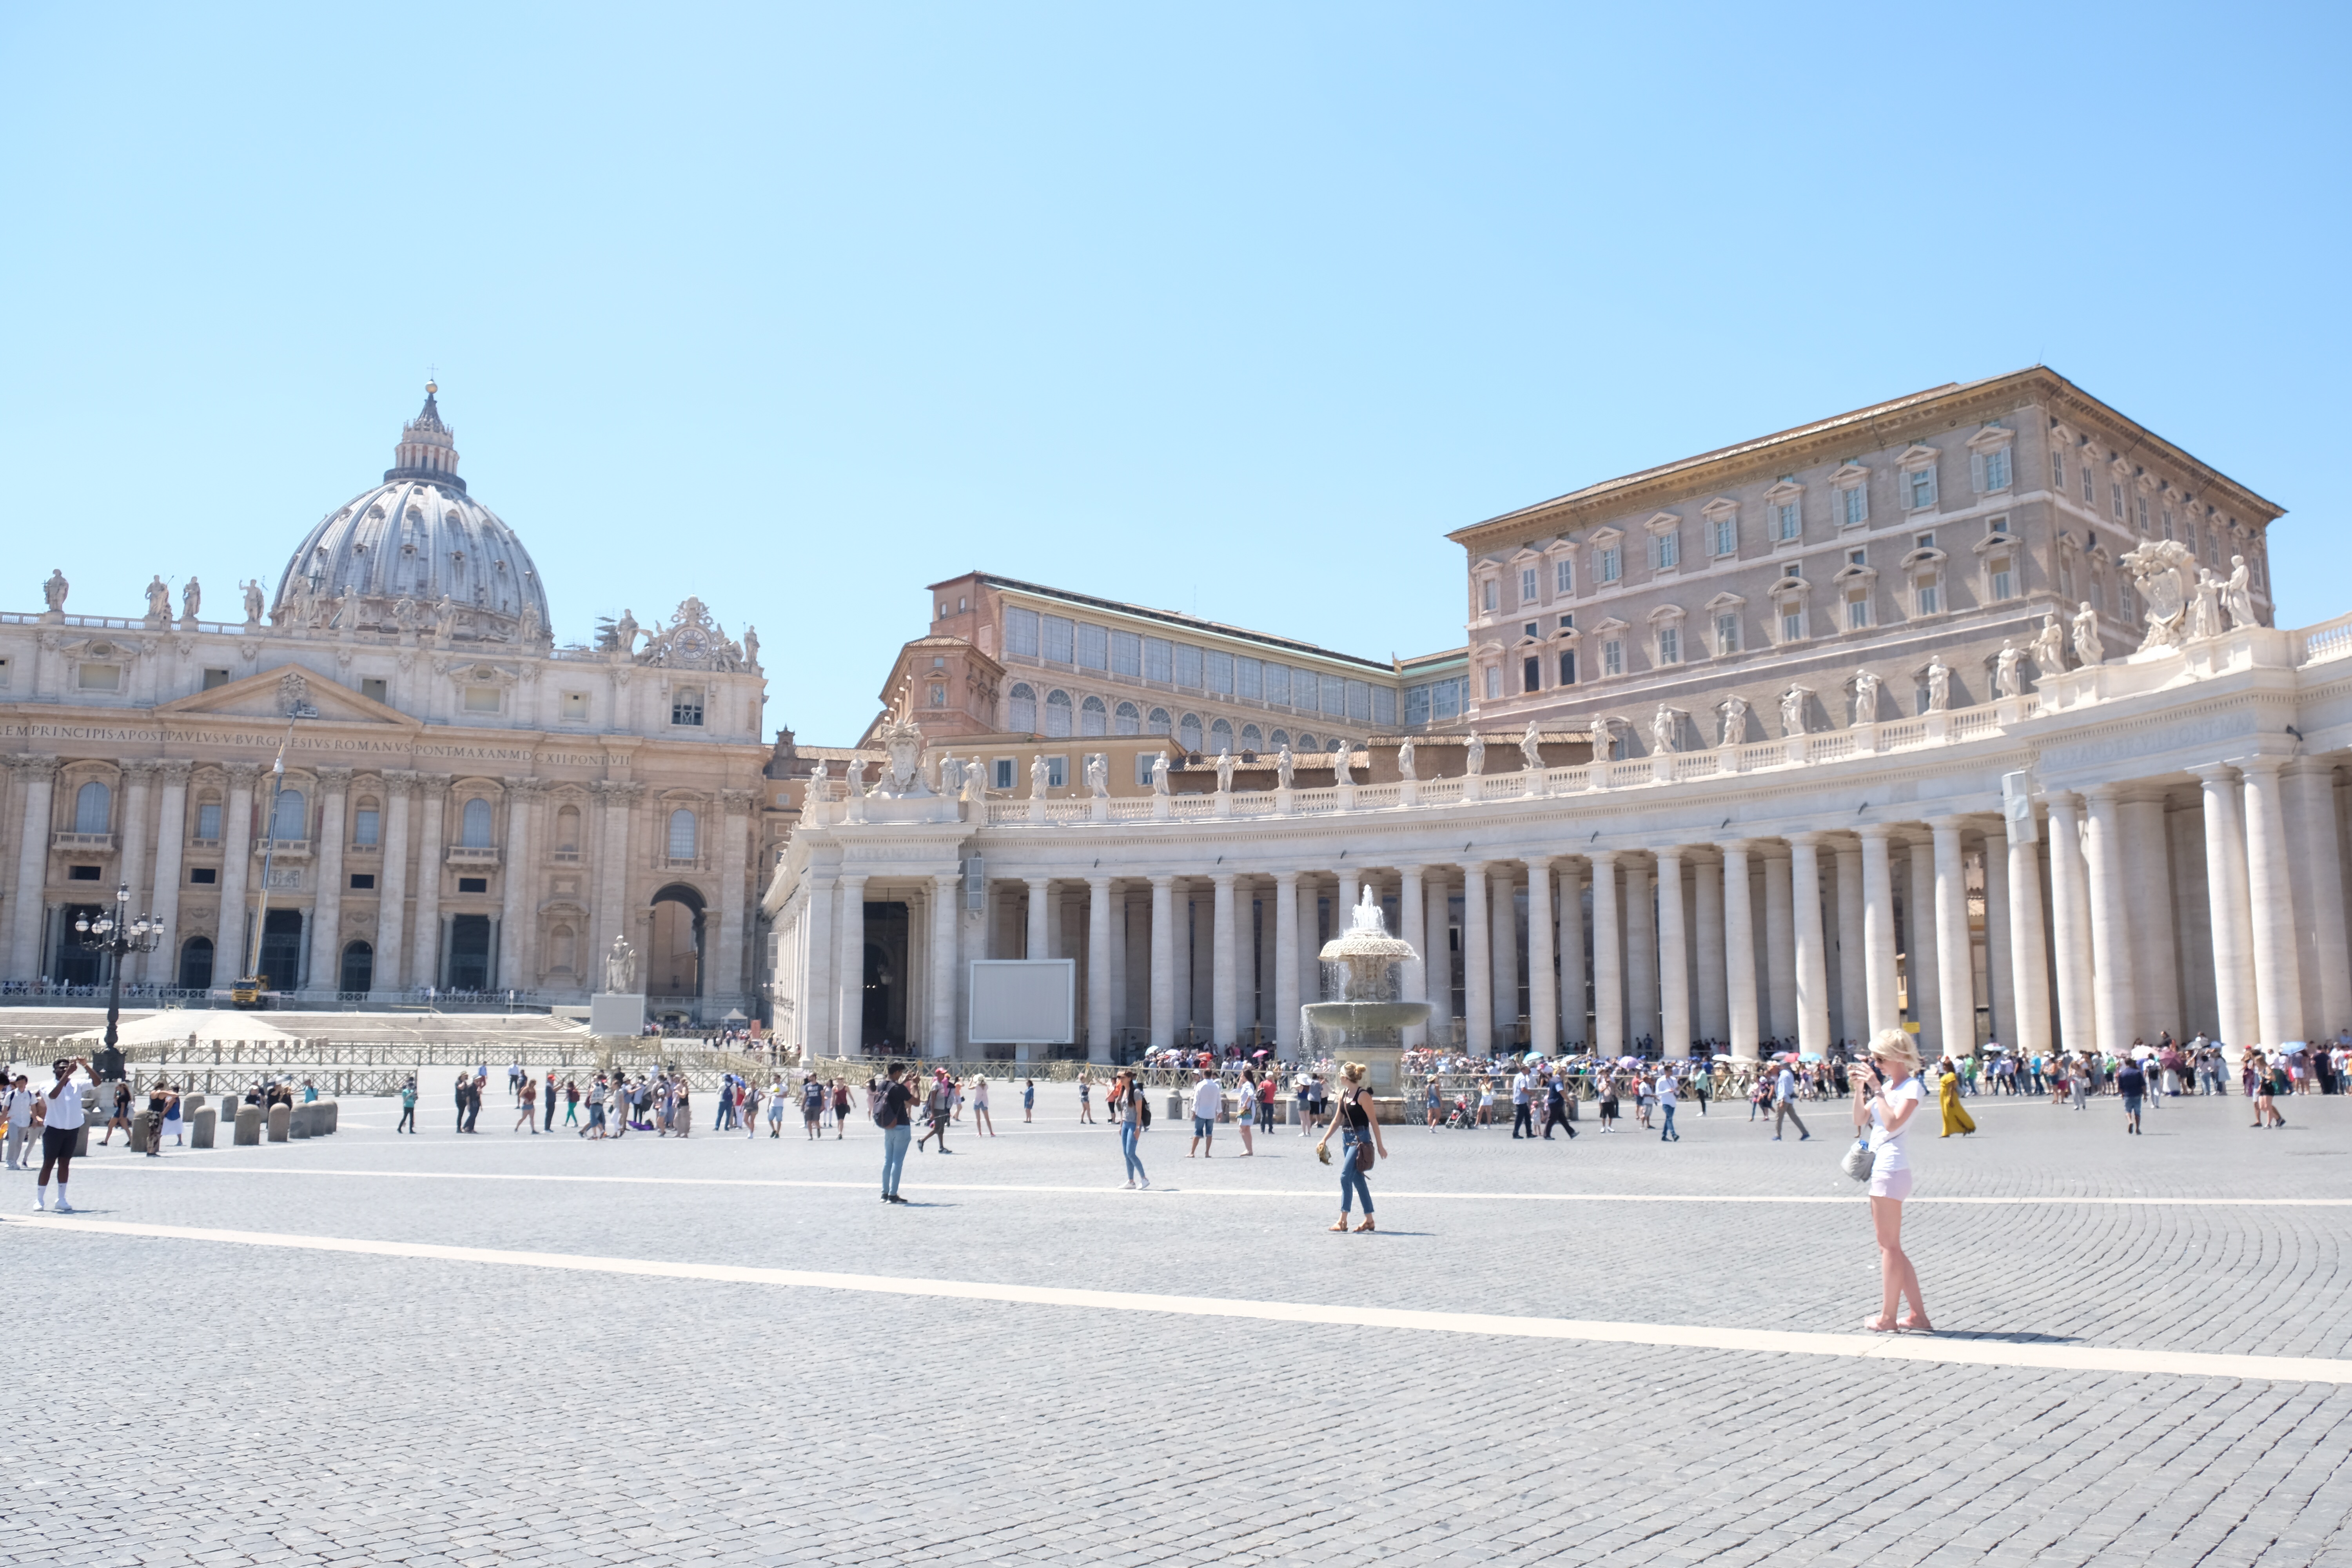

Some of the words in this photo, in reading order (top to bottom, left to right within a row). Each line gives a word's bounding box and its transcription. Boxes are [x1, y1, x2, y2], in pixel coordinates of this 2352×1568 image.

[0, 726, 28, 736] EM
[31, 726, 113, 740] PRINCIPIS
[335, 740, 410, 753] ROMANVS
[611, 755, 630, 765] VII
